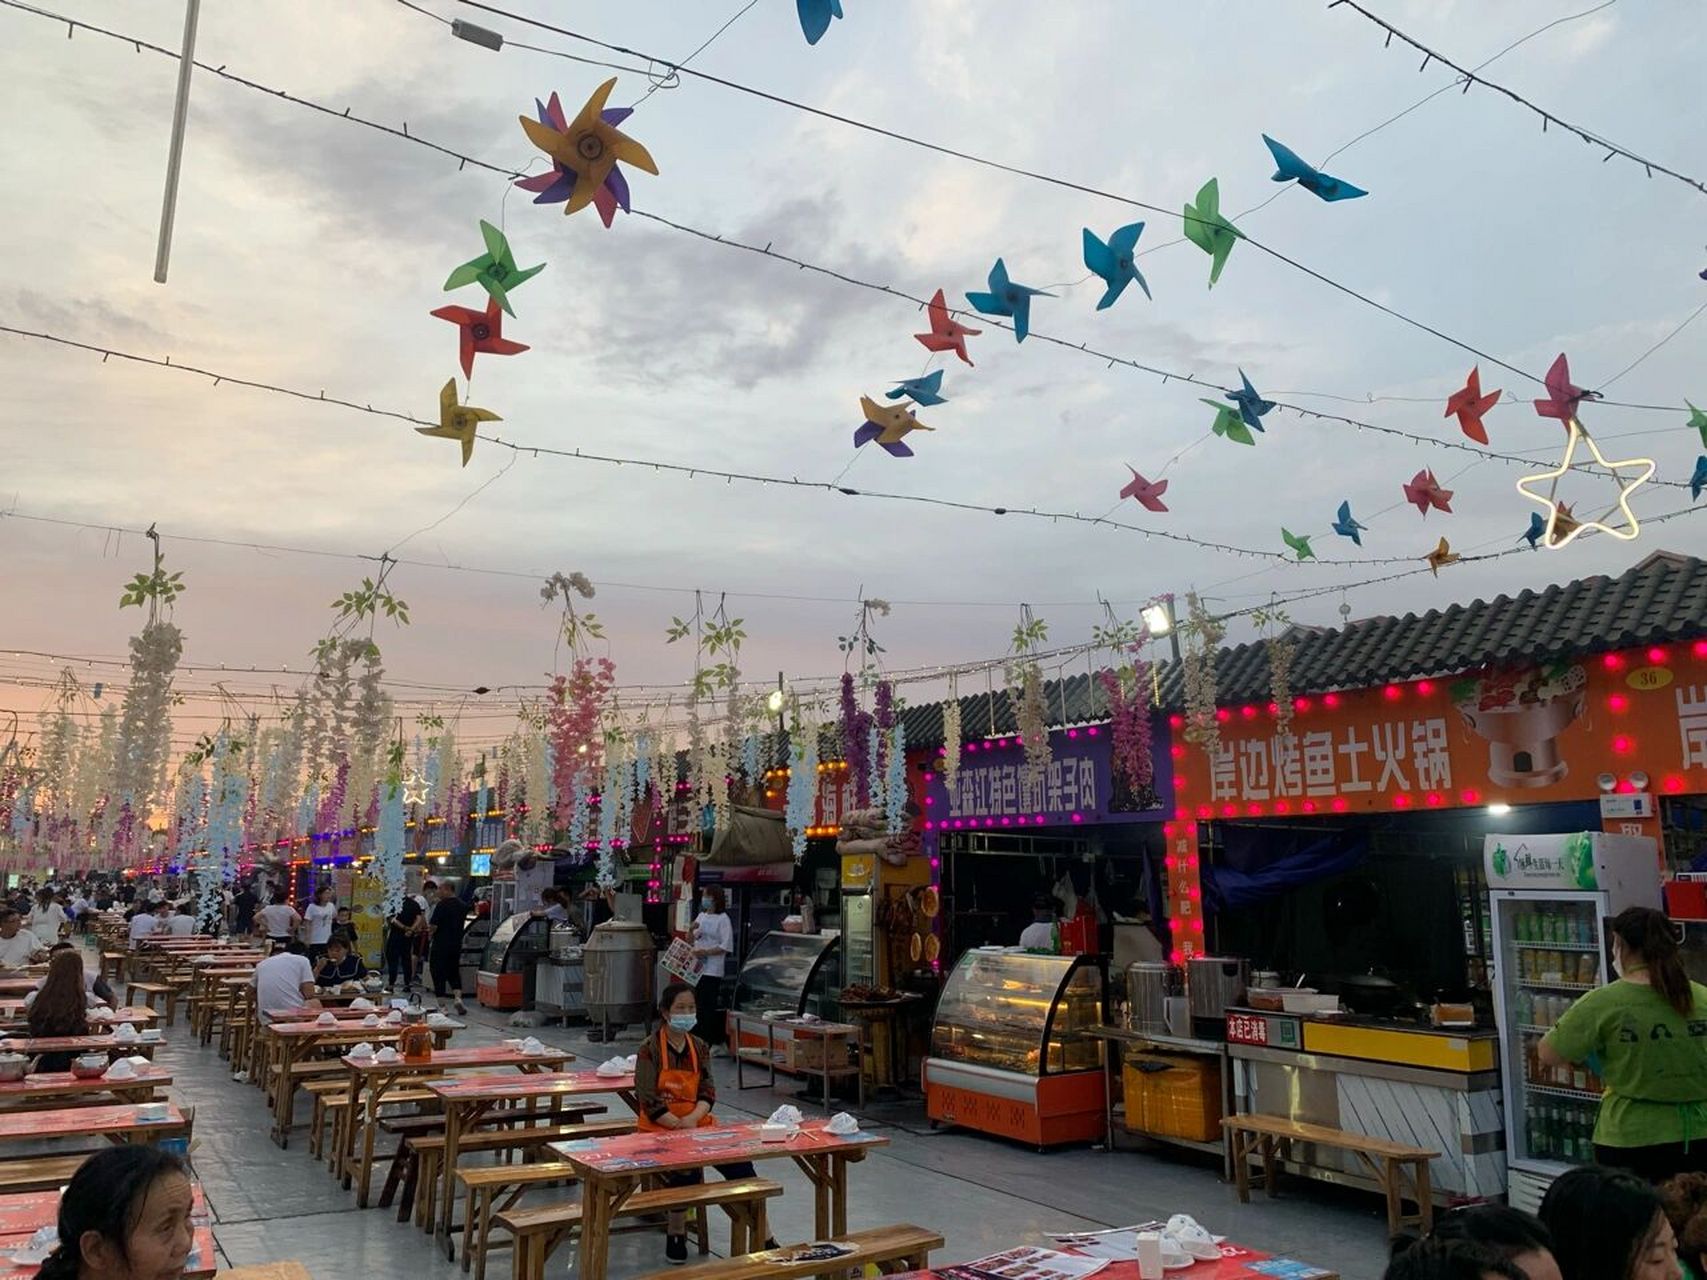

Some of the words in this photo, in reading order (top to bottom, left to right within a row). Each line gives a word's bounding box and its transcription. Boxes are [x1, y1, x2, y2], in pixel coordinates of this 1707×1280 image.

[1640, 671, 1658, 689] 36
[1209, 718, 1452, 802] 岸边烤鱼土火锅
[1228, 1017, 1267, 1042] 本店已消毒
